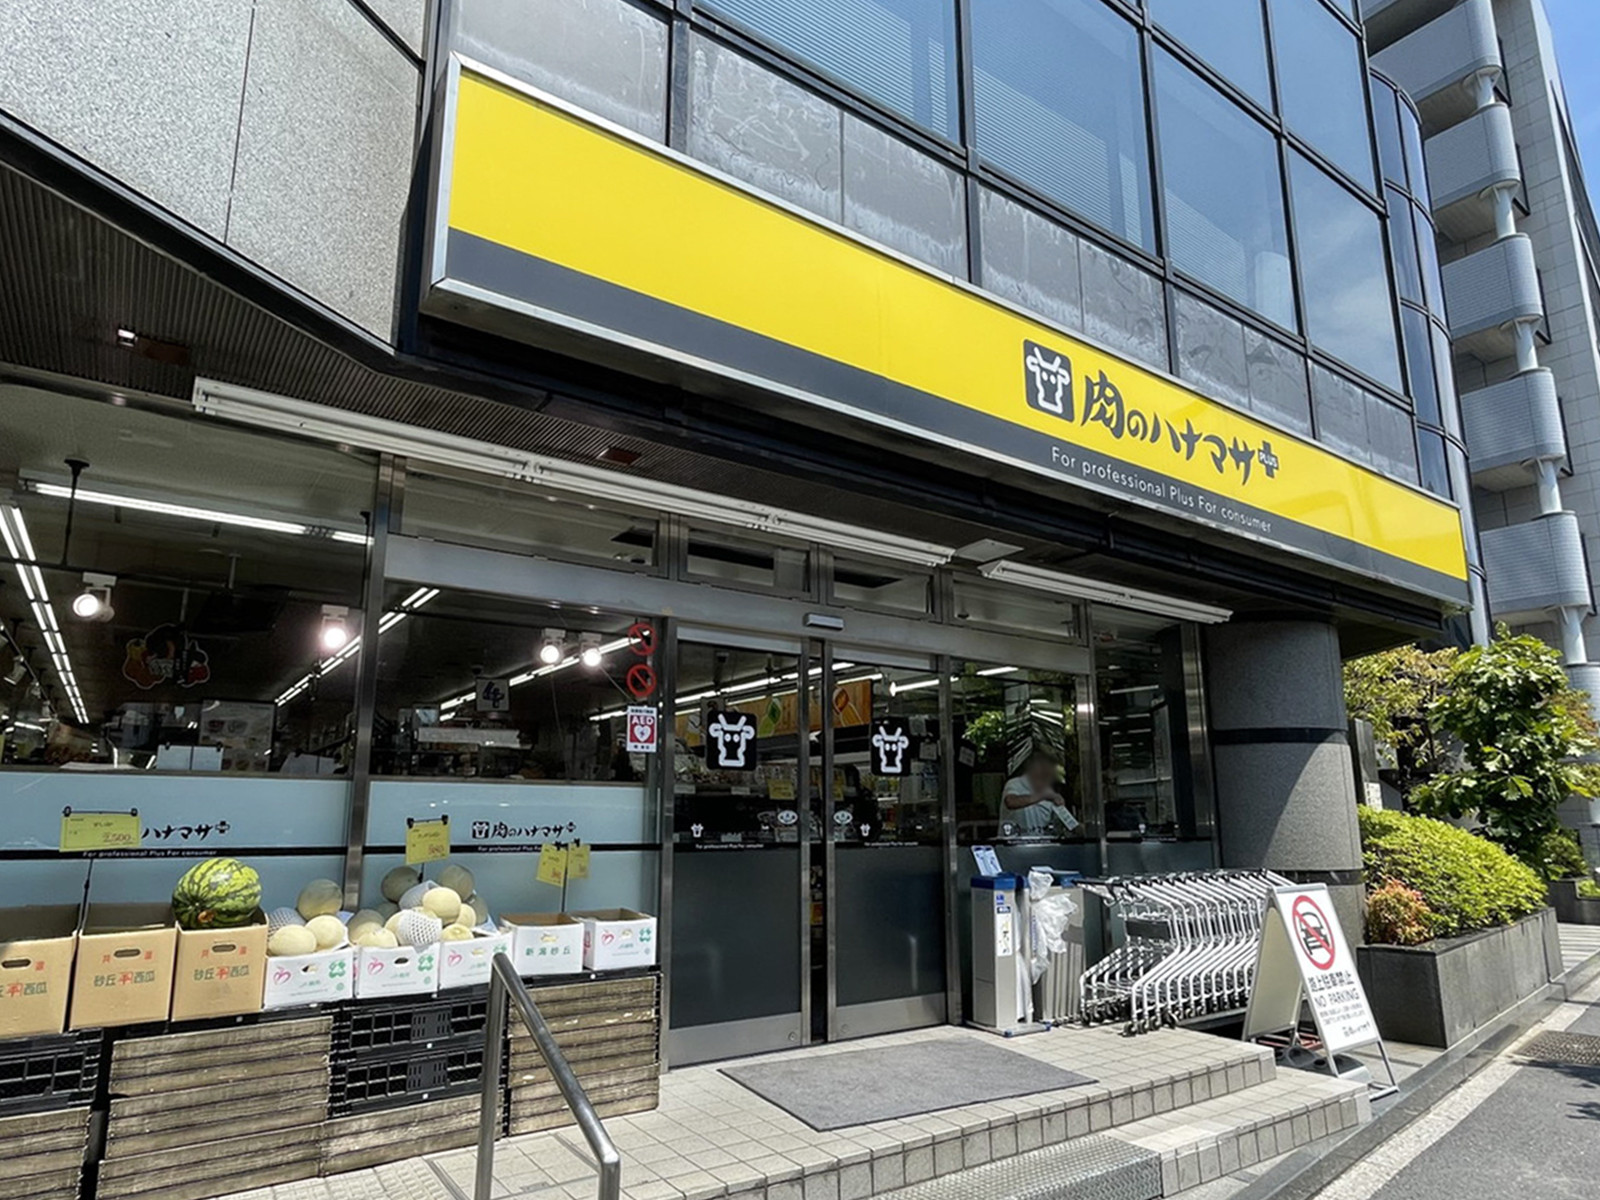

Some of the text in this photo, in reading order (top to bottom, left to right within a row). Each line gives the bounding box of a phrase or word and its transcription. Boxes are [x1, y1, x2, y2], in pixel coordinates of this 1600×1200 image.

[1081, 369, 1277, 486] 肉のハナマサ PLUS
[1051, 446, 1272, 533] For professional Plus For consumer
[631, 715, 654, 726] AED
[141, 824, 213, 840] ハナマサ
[491, 821, 564, 839] 肉のハナマサ
[1314, 988, 1360, 1007] NO PARKING
